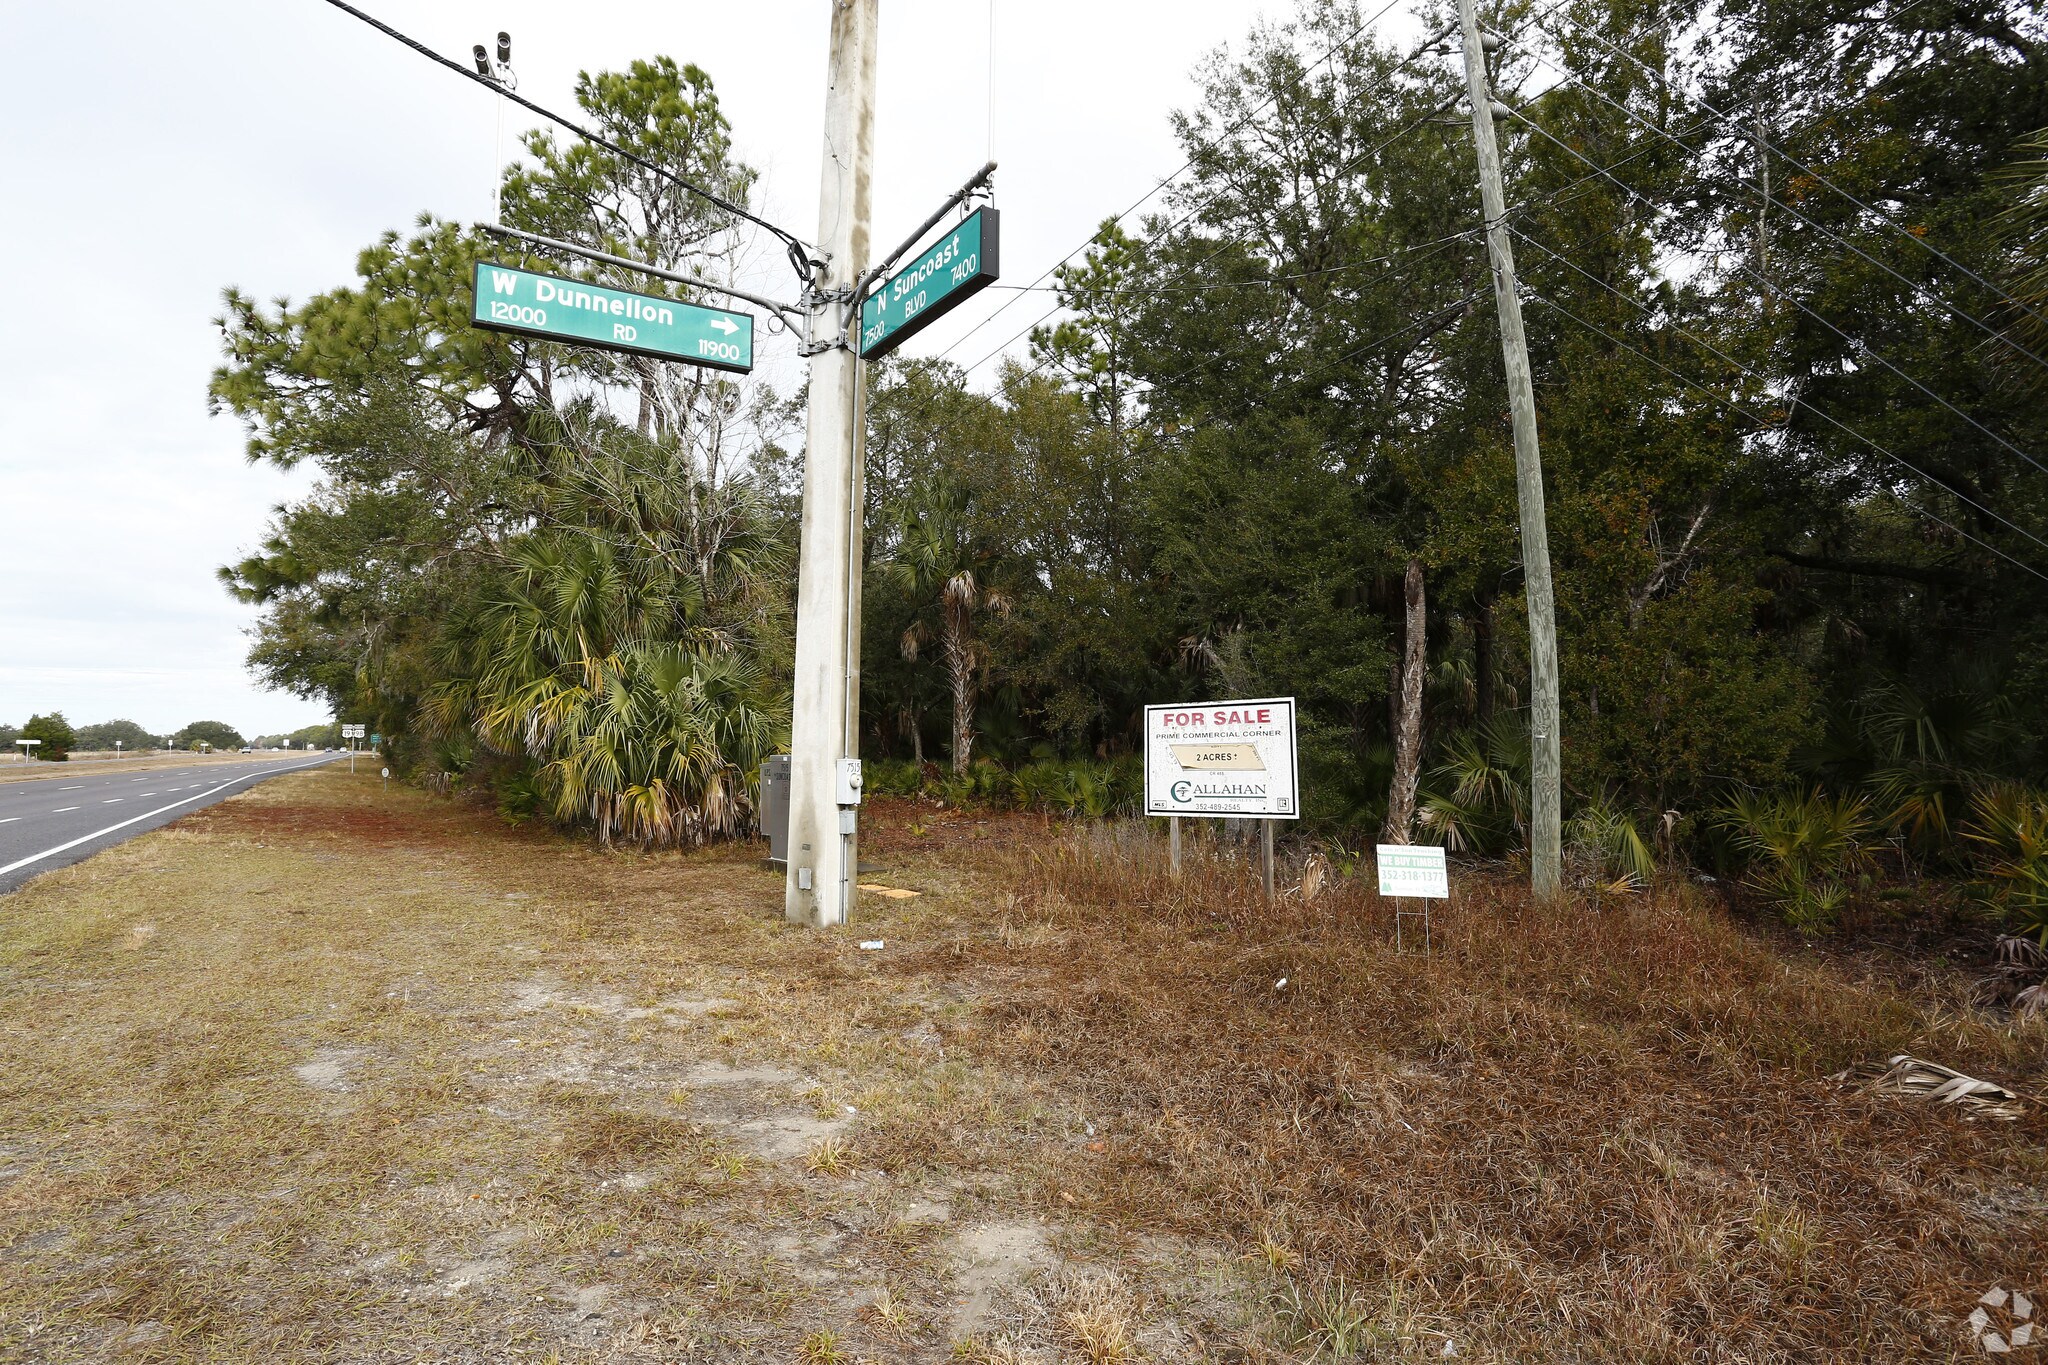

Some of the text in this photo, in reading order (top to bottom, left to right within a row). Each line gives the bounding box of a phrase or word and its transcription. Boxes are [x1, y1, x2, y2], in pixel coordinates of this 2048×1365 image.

[877, 233, 960, 315] N Suncoast
[950, 253, 976, 286] 7400
[491, 270, 673, 325] W Dunnellon
[905, 289, 927, 319] BLVD
[490, 300, 547, 326] 12000
[613, 323, 637, 342] RD
[864, 320, 885, 348] 7500
[698, 338, 740, 360] 11900
[1163, 709, 1271, 727] FOR SALE
[1156, 729, 1282, 740] PRIME COMMERCIAL CORNER
[846, 762, 861, 773] 7515
[1196, 753, 1201, 762] 2
[1202, 753, 1232, 761] ACRES
[1195, 803, 1241, 811] 352-489-2545
[1380, 855, 1443, 868] WE BUY TIMBER
